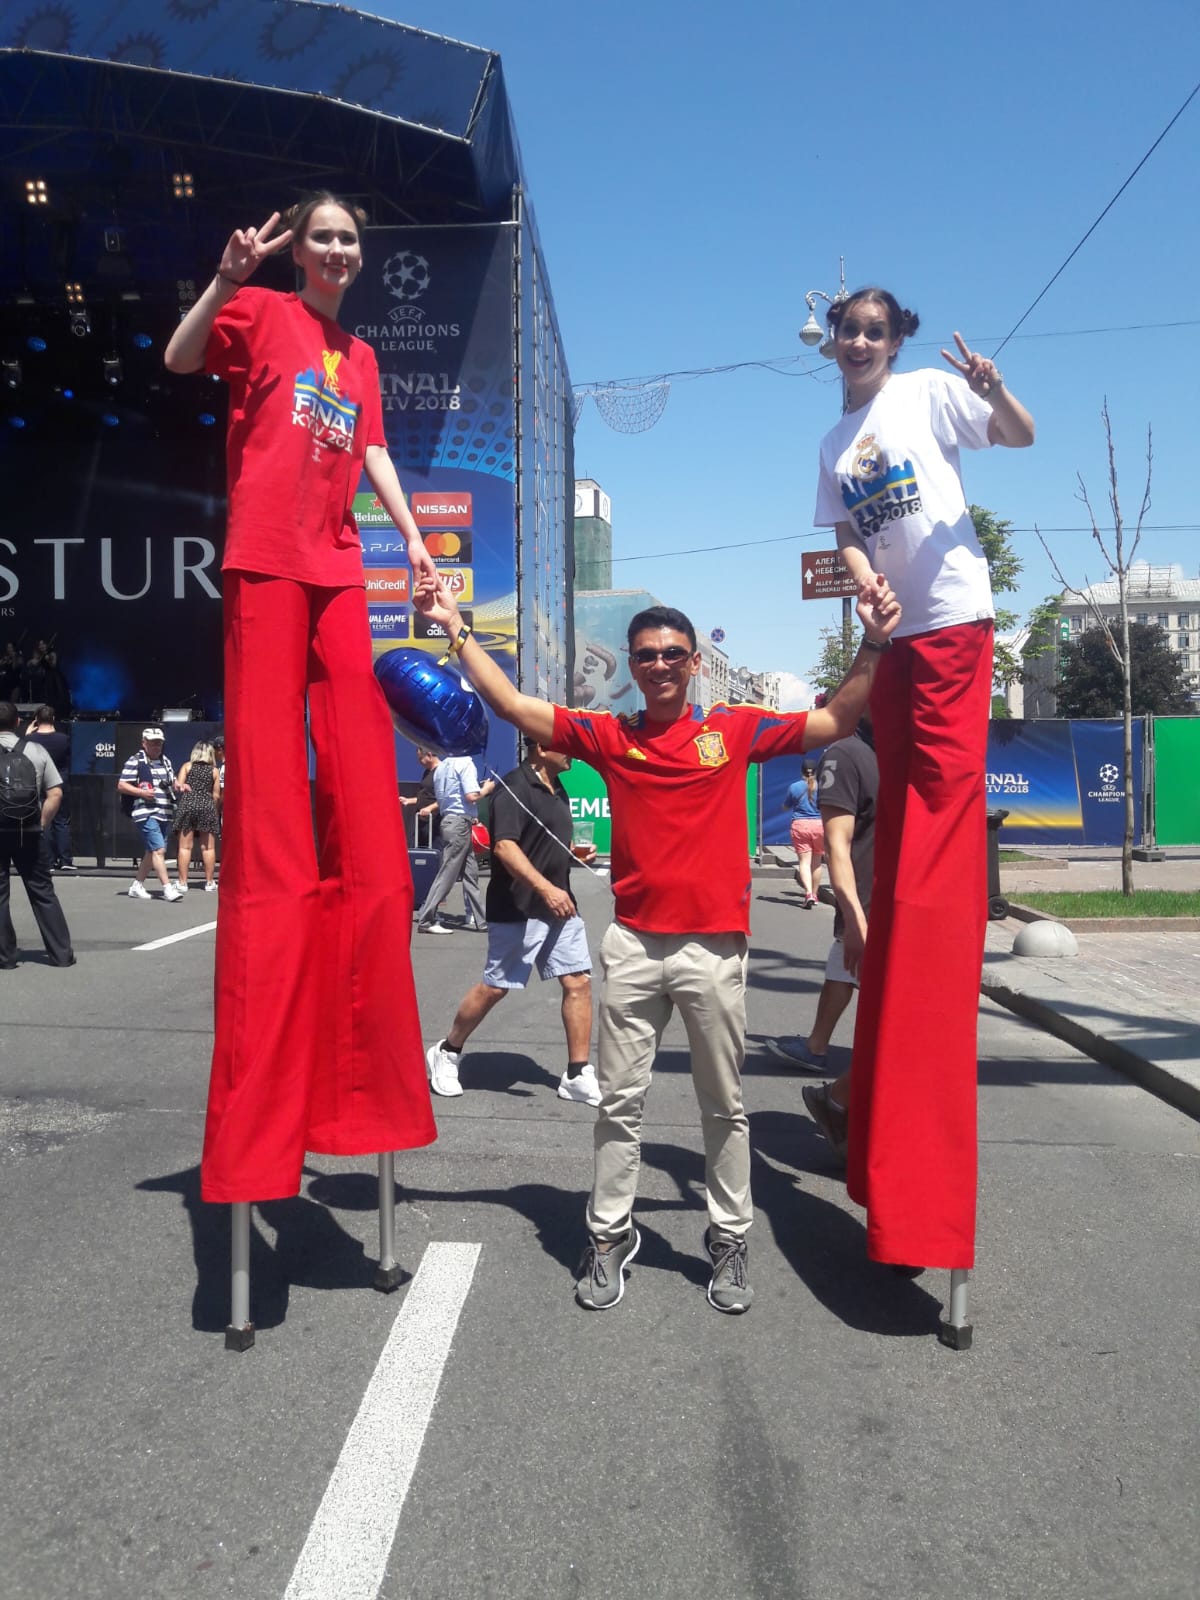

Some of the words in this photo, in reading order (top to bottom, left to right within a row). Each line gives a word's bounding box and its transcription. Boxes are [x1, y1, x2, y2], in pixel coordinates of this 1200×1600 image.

[390, 307, 423, 321] UEFA
[355, 324, 460, 338] CHAMPIONS
[381, 340, 434, 351] LEAGUE
[382, 395, 409, 411] IV
[415, 394, 461, 411] 2018
[416, 505, 468, 514] NISSAN
[883, 499, 922, 522] 2018
[370, 543, 406, 553] PS4
[384, 614, 408, 623] GAME
[1003, 785, 1029, 793] 2018
